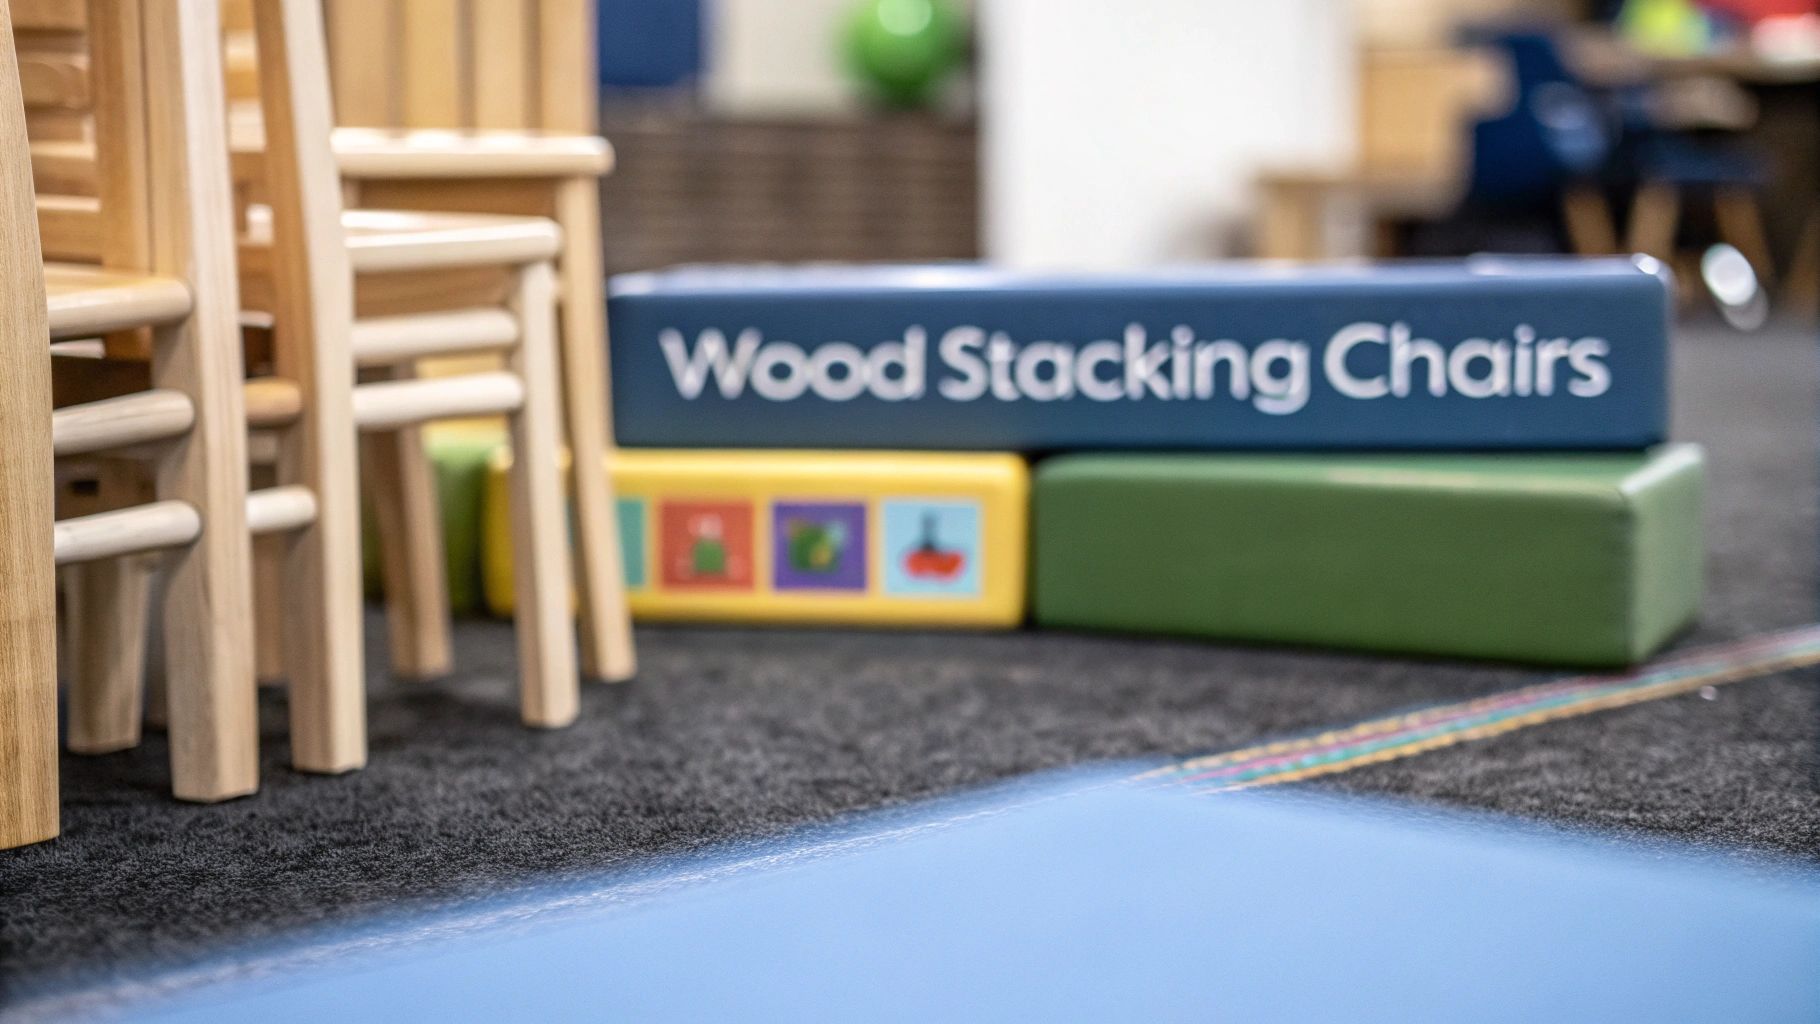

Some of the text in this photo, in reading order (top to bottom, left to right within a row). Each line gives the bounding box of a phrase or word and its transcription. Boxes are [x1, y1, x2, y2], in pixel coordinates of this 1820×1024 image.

[660, 323, 1611, 414] Wood Stacking Chairs
